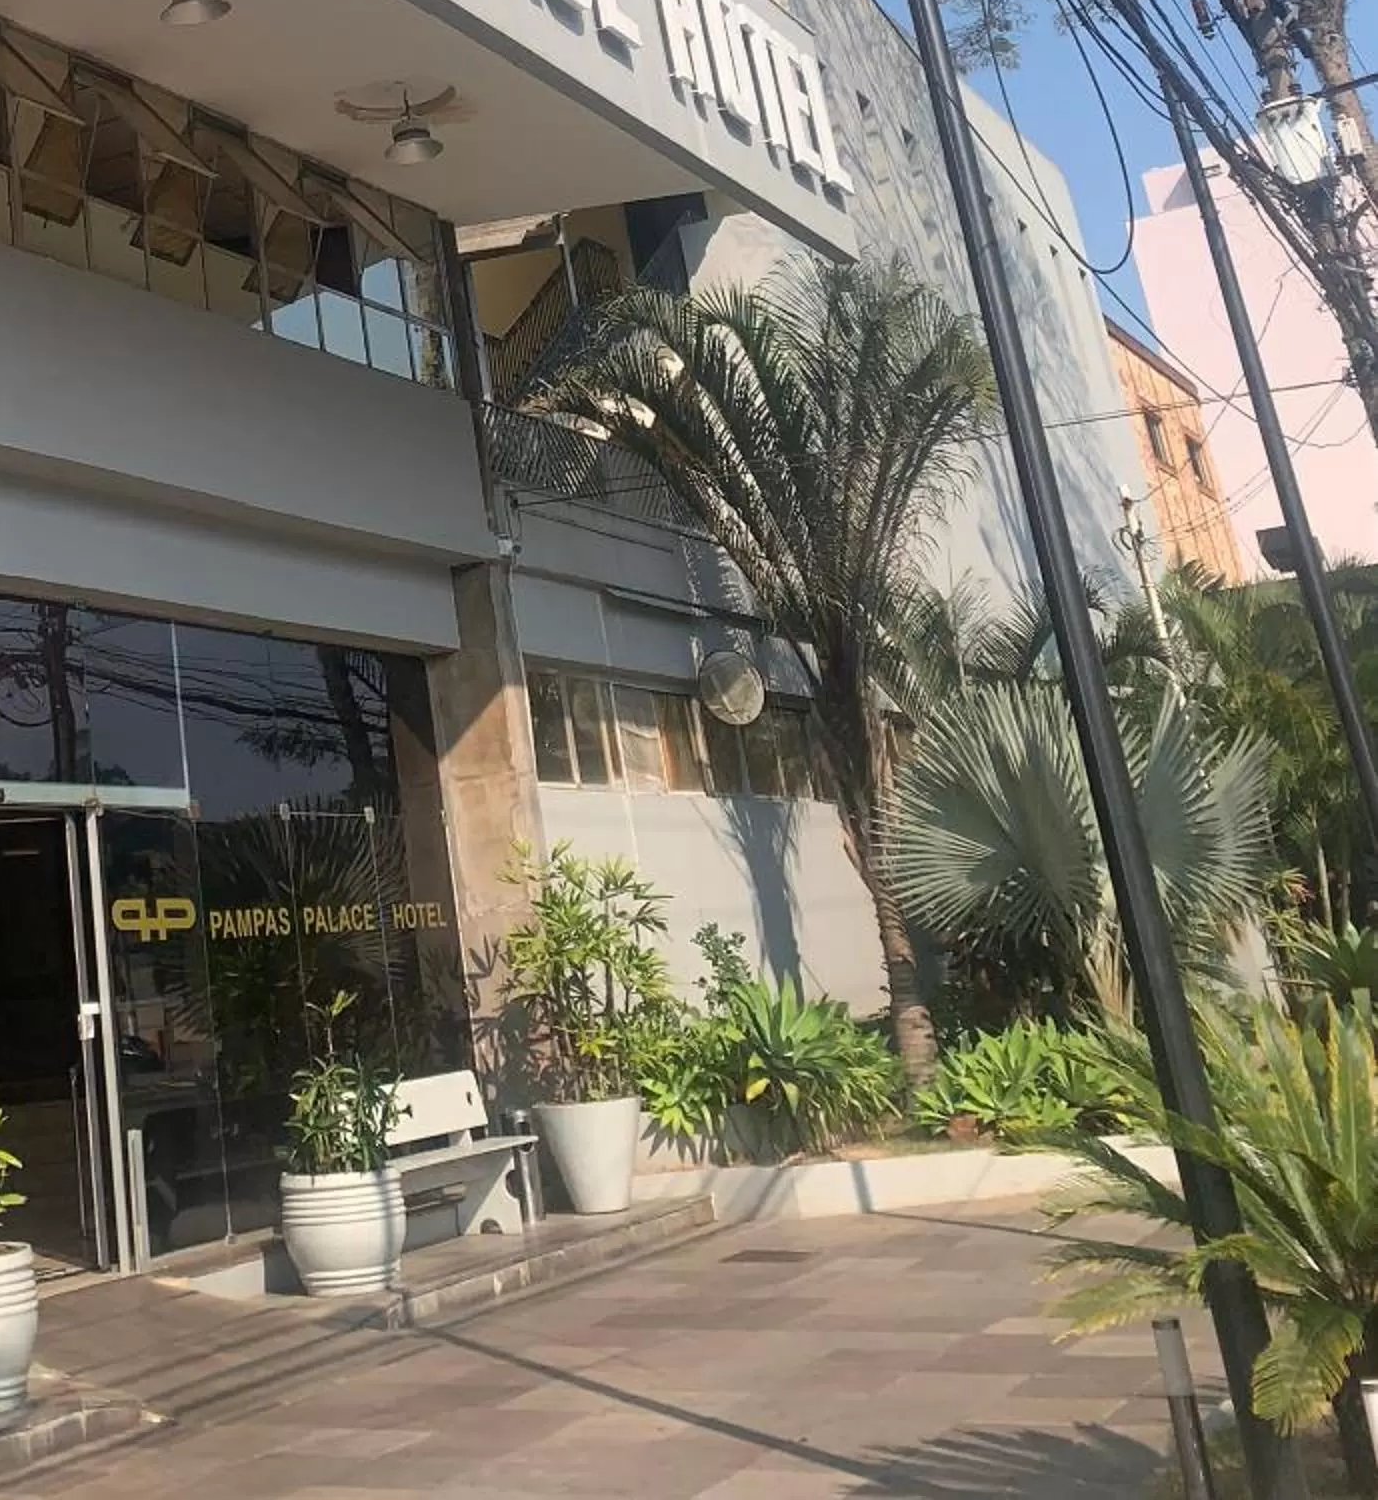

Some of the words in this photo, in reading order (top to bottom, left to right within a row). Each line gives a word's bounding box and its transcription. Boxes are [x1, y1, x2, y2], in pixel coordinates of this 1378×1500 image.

[209, 906, 292, 940] PAMPAS
[303, 902, 375, 936] PALACE
[391, 901, 448, 931] HOTEL
